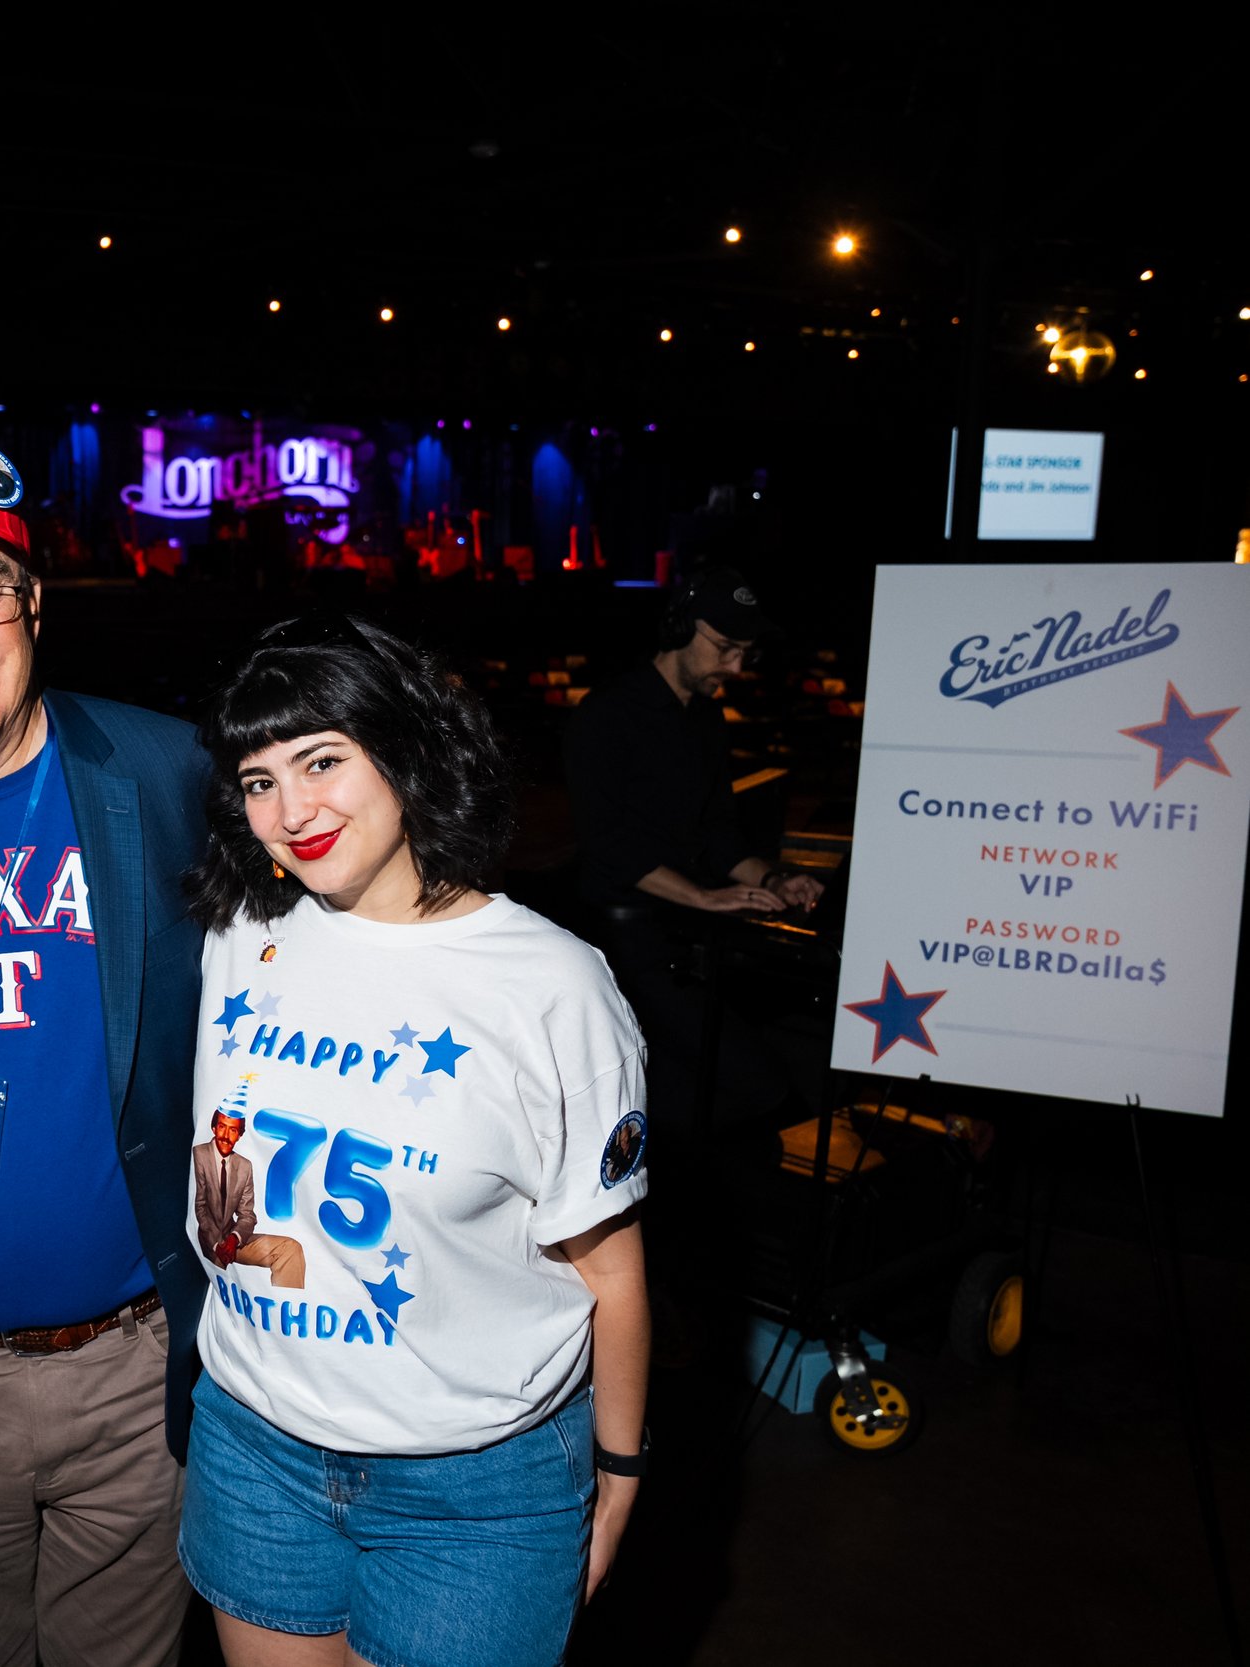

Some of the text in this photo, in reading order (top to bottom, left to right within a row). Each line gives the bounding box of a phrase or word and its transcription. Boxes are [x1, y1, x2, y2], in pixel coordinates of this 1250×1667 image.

[939, 588, 1178, 698] Eric Nadel
[1003, 646, 1145, 697] BIRTHDAY BENEFIT
[899, 789, 1199, 831] Connect to WiFi
[980, 844, 1119, 870] NETWORK
[1019, 873, 1074, 898] VIP
[965, 917, 1121, 947] PASSWORD
[919, 939, 1167, 987] VIP@LBRDalla$
[248, 1023, 401, 1084] HAPPY
[216, 1274, 401, 1347] BIRTHDAY
